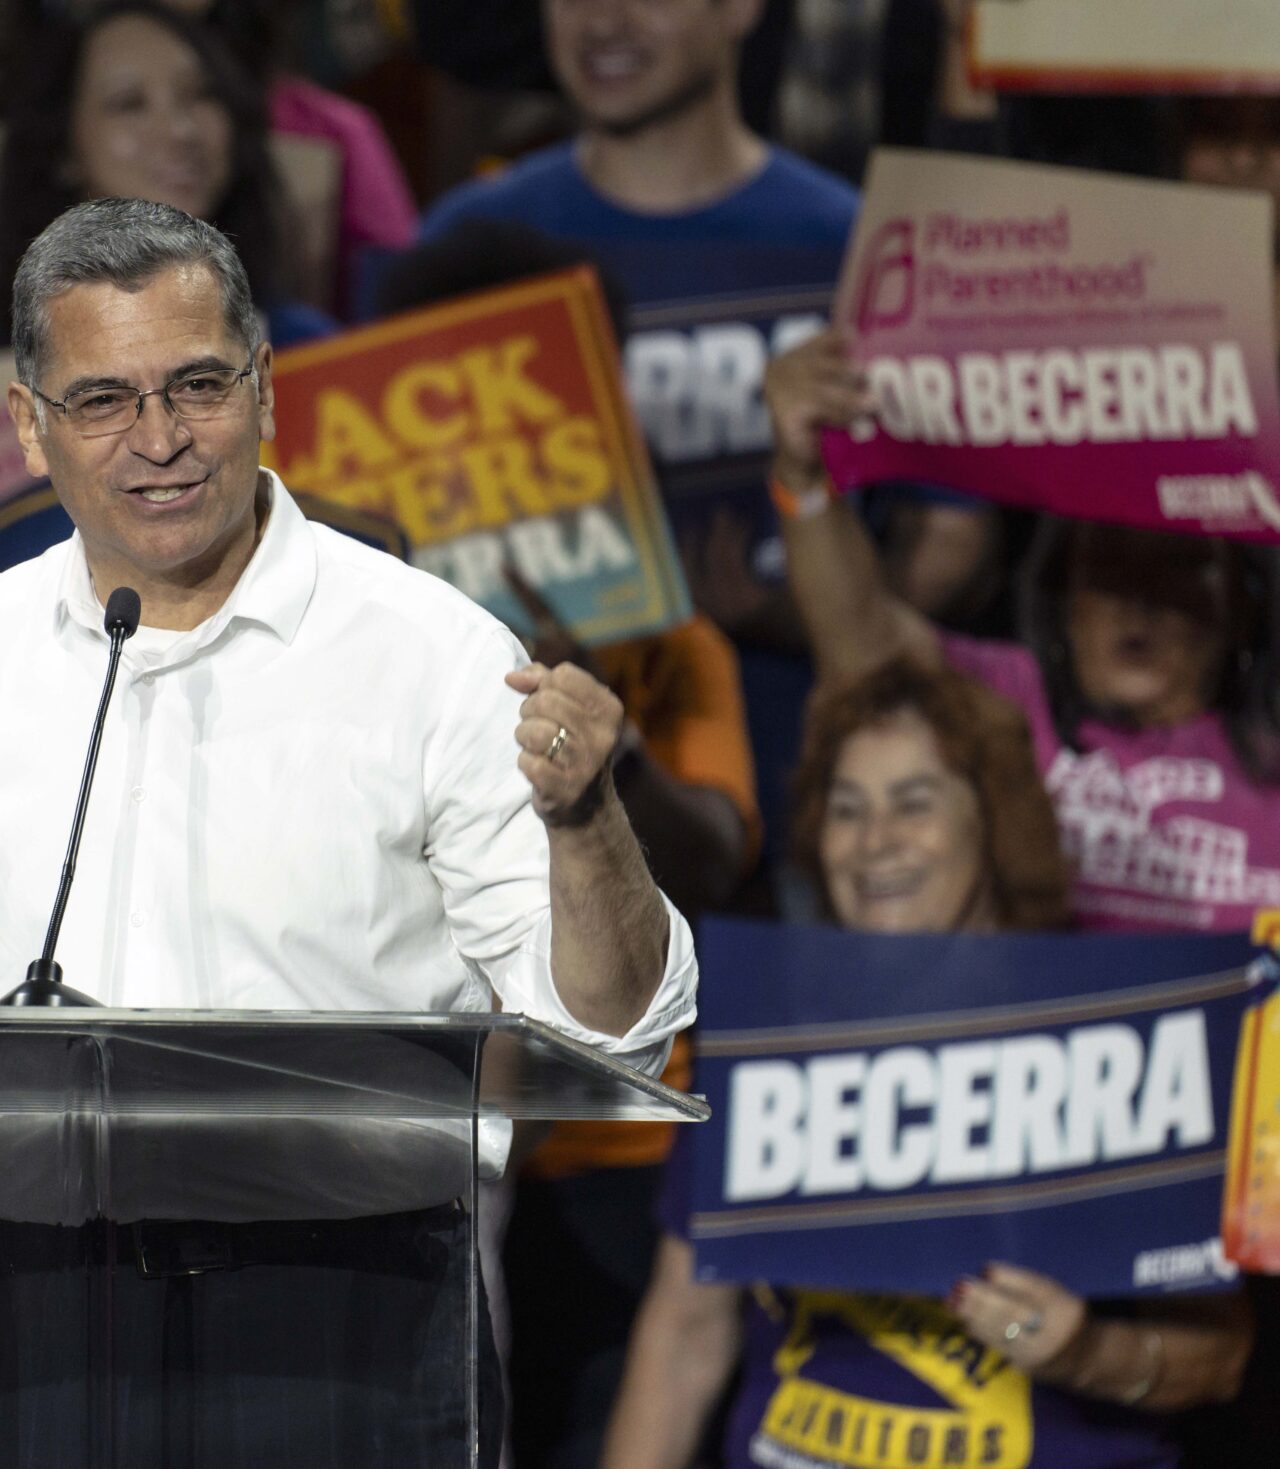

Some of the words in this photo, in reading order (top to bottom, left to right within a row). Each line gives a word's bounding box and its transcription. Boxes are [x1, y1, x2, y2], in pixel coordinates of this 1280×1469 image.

[925, 208, 1070, 257] Planned
[923, 258, 1147, 300] Parenthood
[850, 354, 962, 445] OR
[958, 343, 1258, 447] BECERRA
[726, 1008, 1215, 1202] BECERRA
